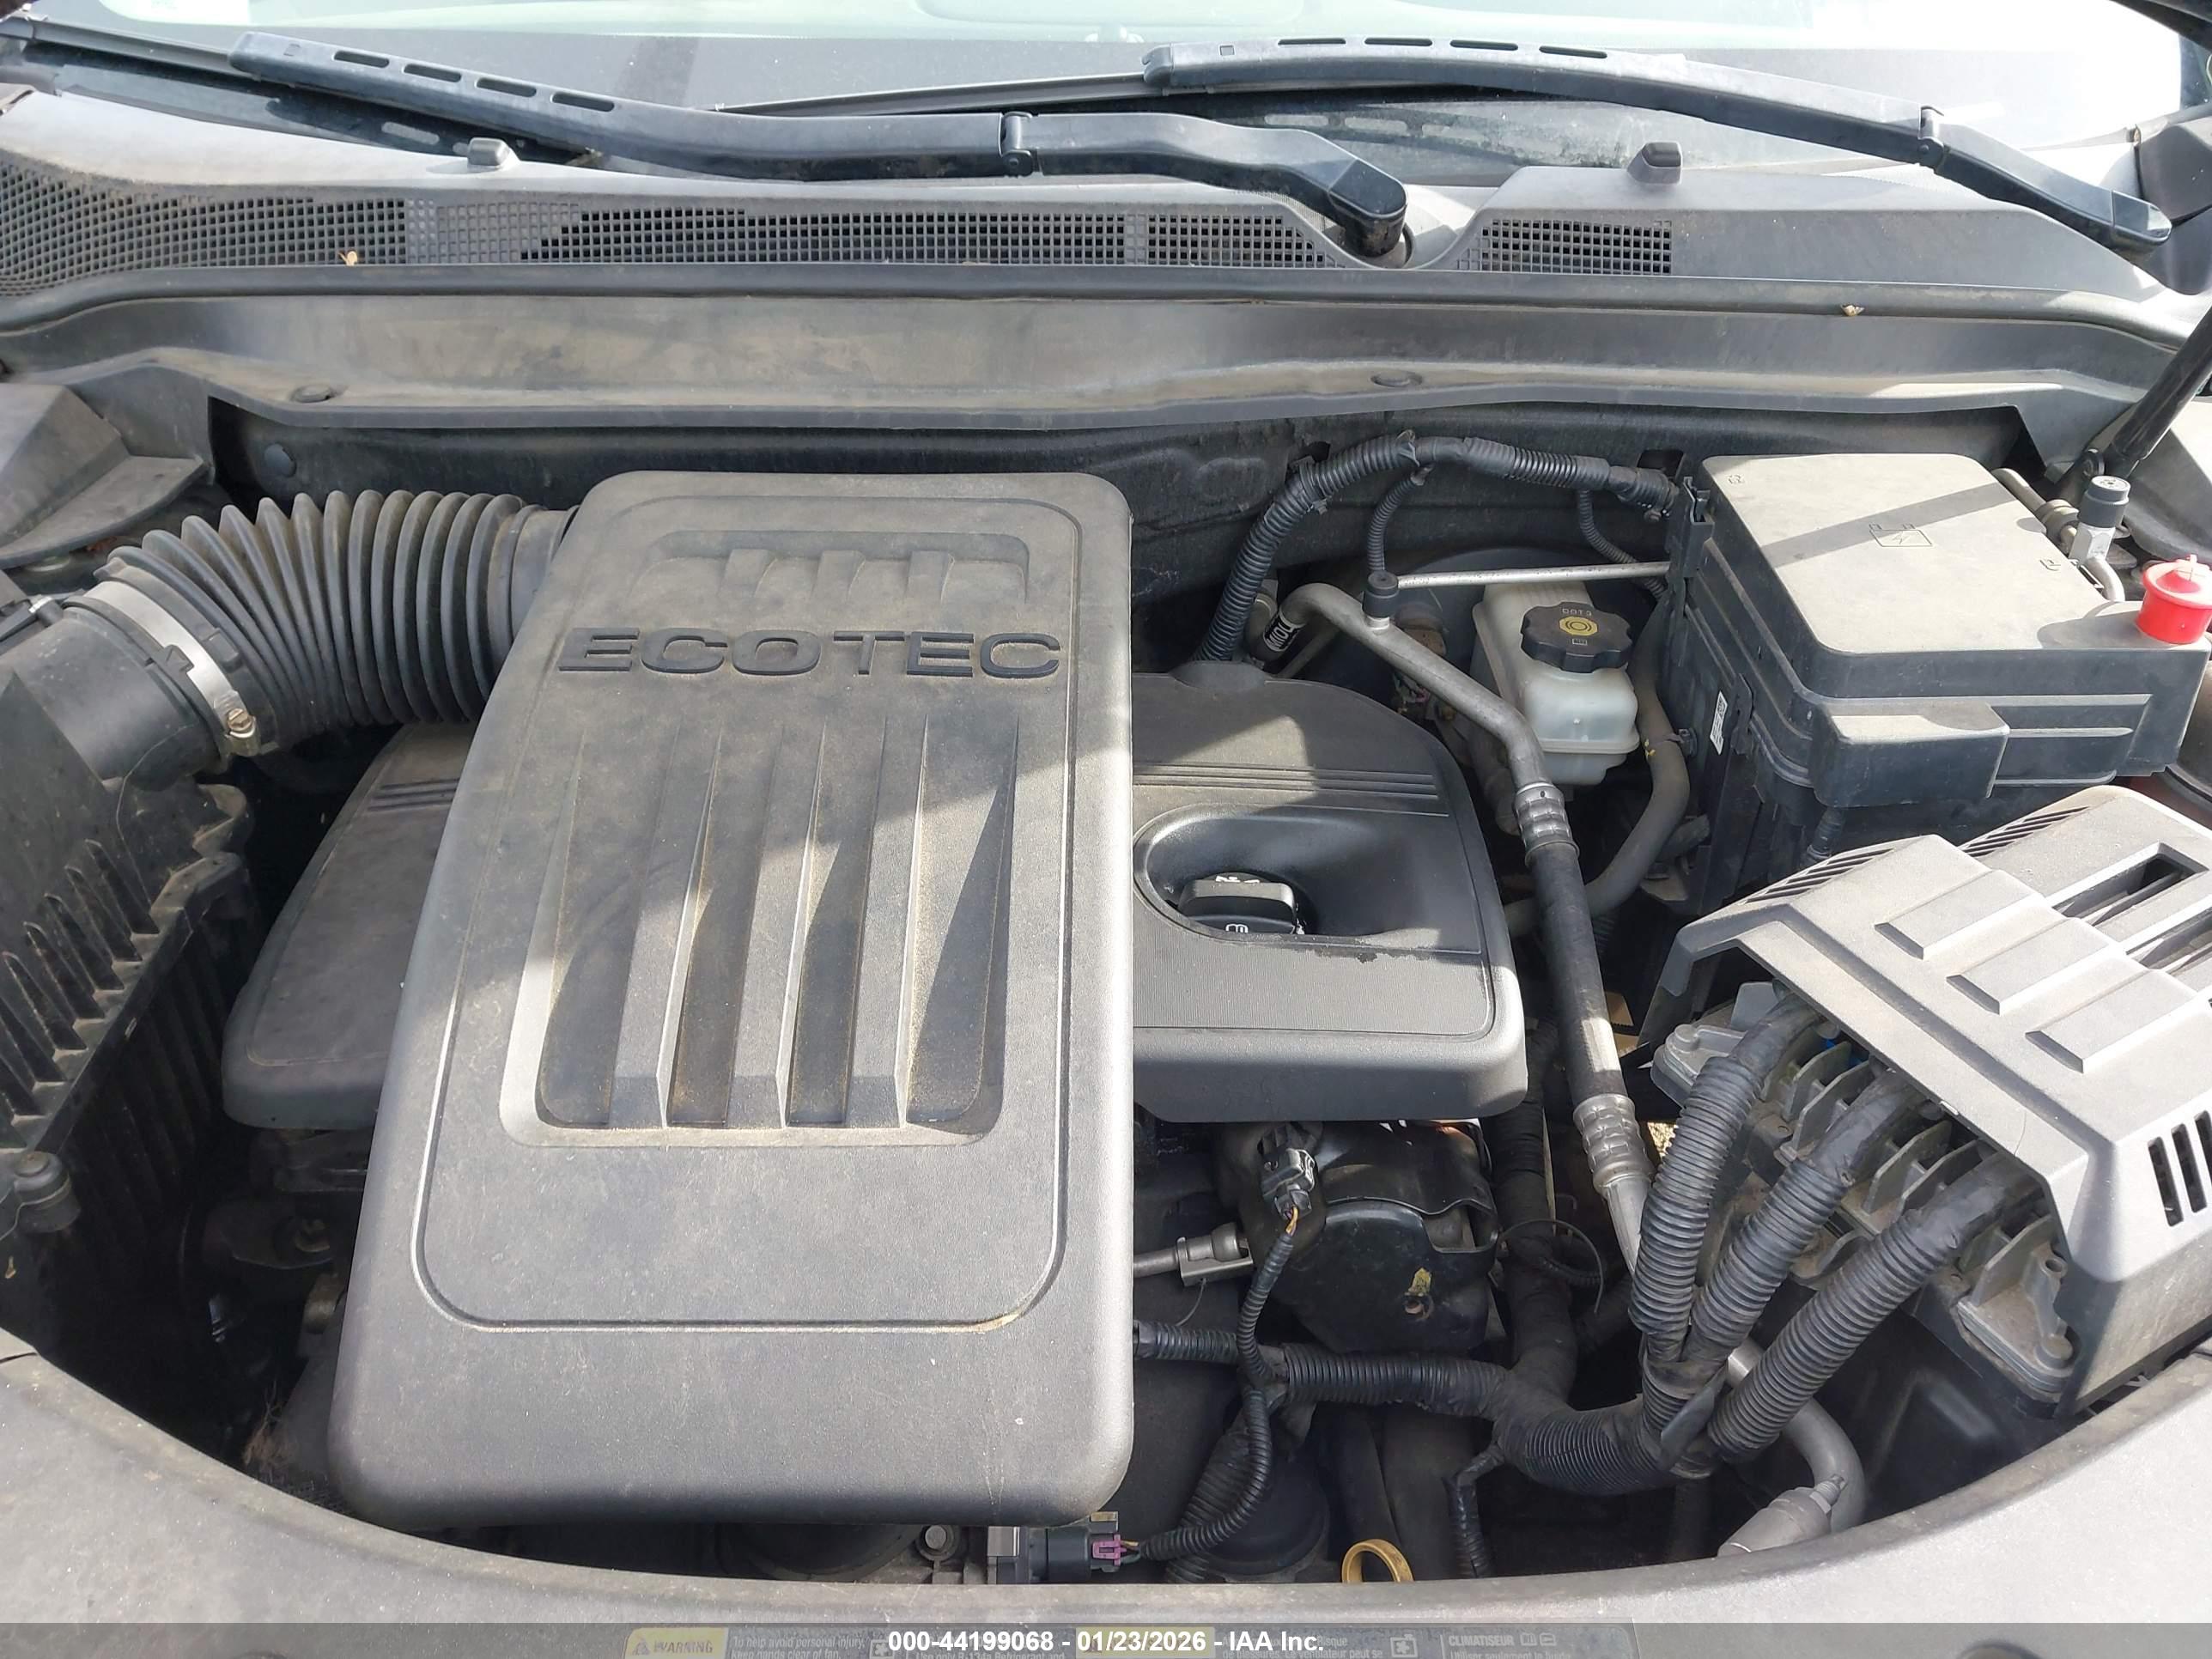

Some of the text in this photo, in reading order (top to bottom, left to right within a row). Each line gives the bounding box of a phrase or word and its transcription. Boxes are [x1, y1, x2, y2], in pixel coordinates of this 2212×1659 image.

[558, 627, 1060, 678] ECOTEC
[653, 1639, 713, 1654] WARNING
[733, 1636, 744, 1647] To
[747, 1636, 767, 1650] help
[769, 1635, 793, 1648] avoid
[795, 1635, 836, 1650] personal
[1448, 1634, 1515, 1647] CLIMATISEUR
